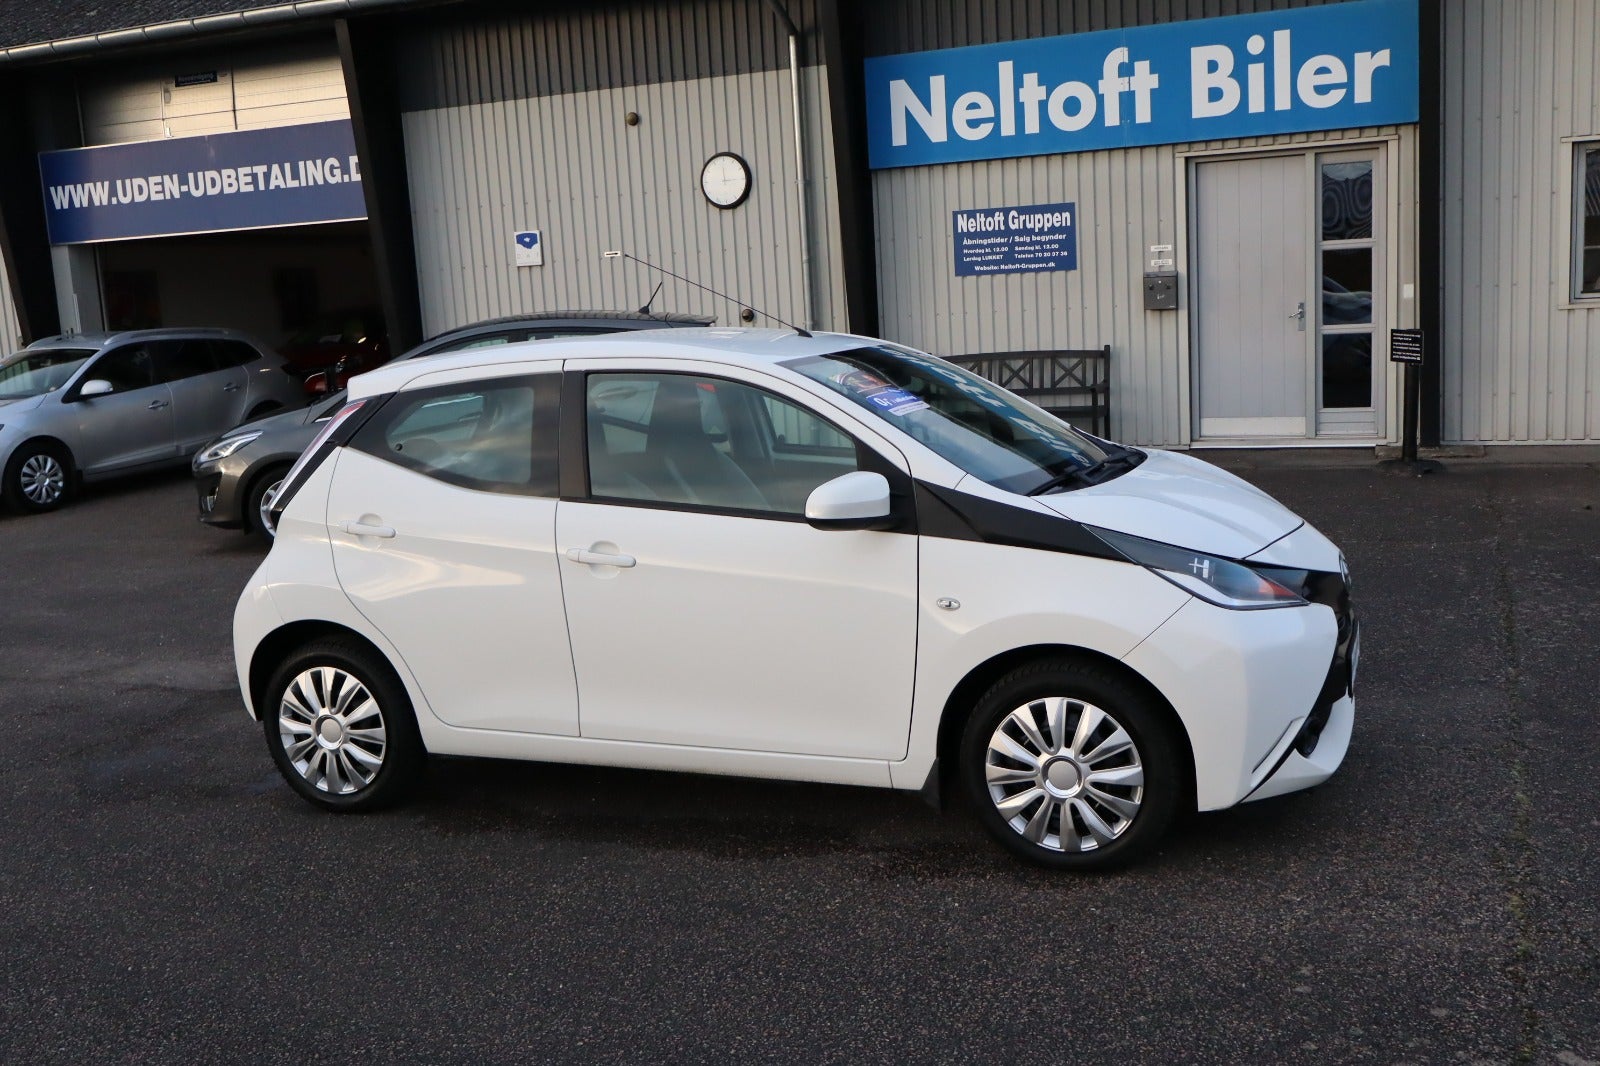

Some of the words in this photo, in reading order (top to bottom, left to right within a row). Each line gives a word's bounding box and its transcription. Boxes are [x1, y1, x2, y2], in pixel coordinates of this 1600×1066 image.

[890, 46, 1159, 147] Neltoft
[1191, 29, 1390, 119] Biler
[957, 211, 1005, 232] Neltoft
[1008, 210, 1071, 232] Gruppen
[962, 237, 1008, 245] Åbningstider
[1014, 235, 1031, 243] Salg
[1032, 233, 1067, 242] begynder
